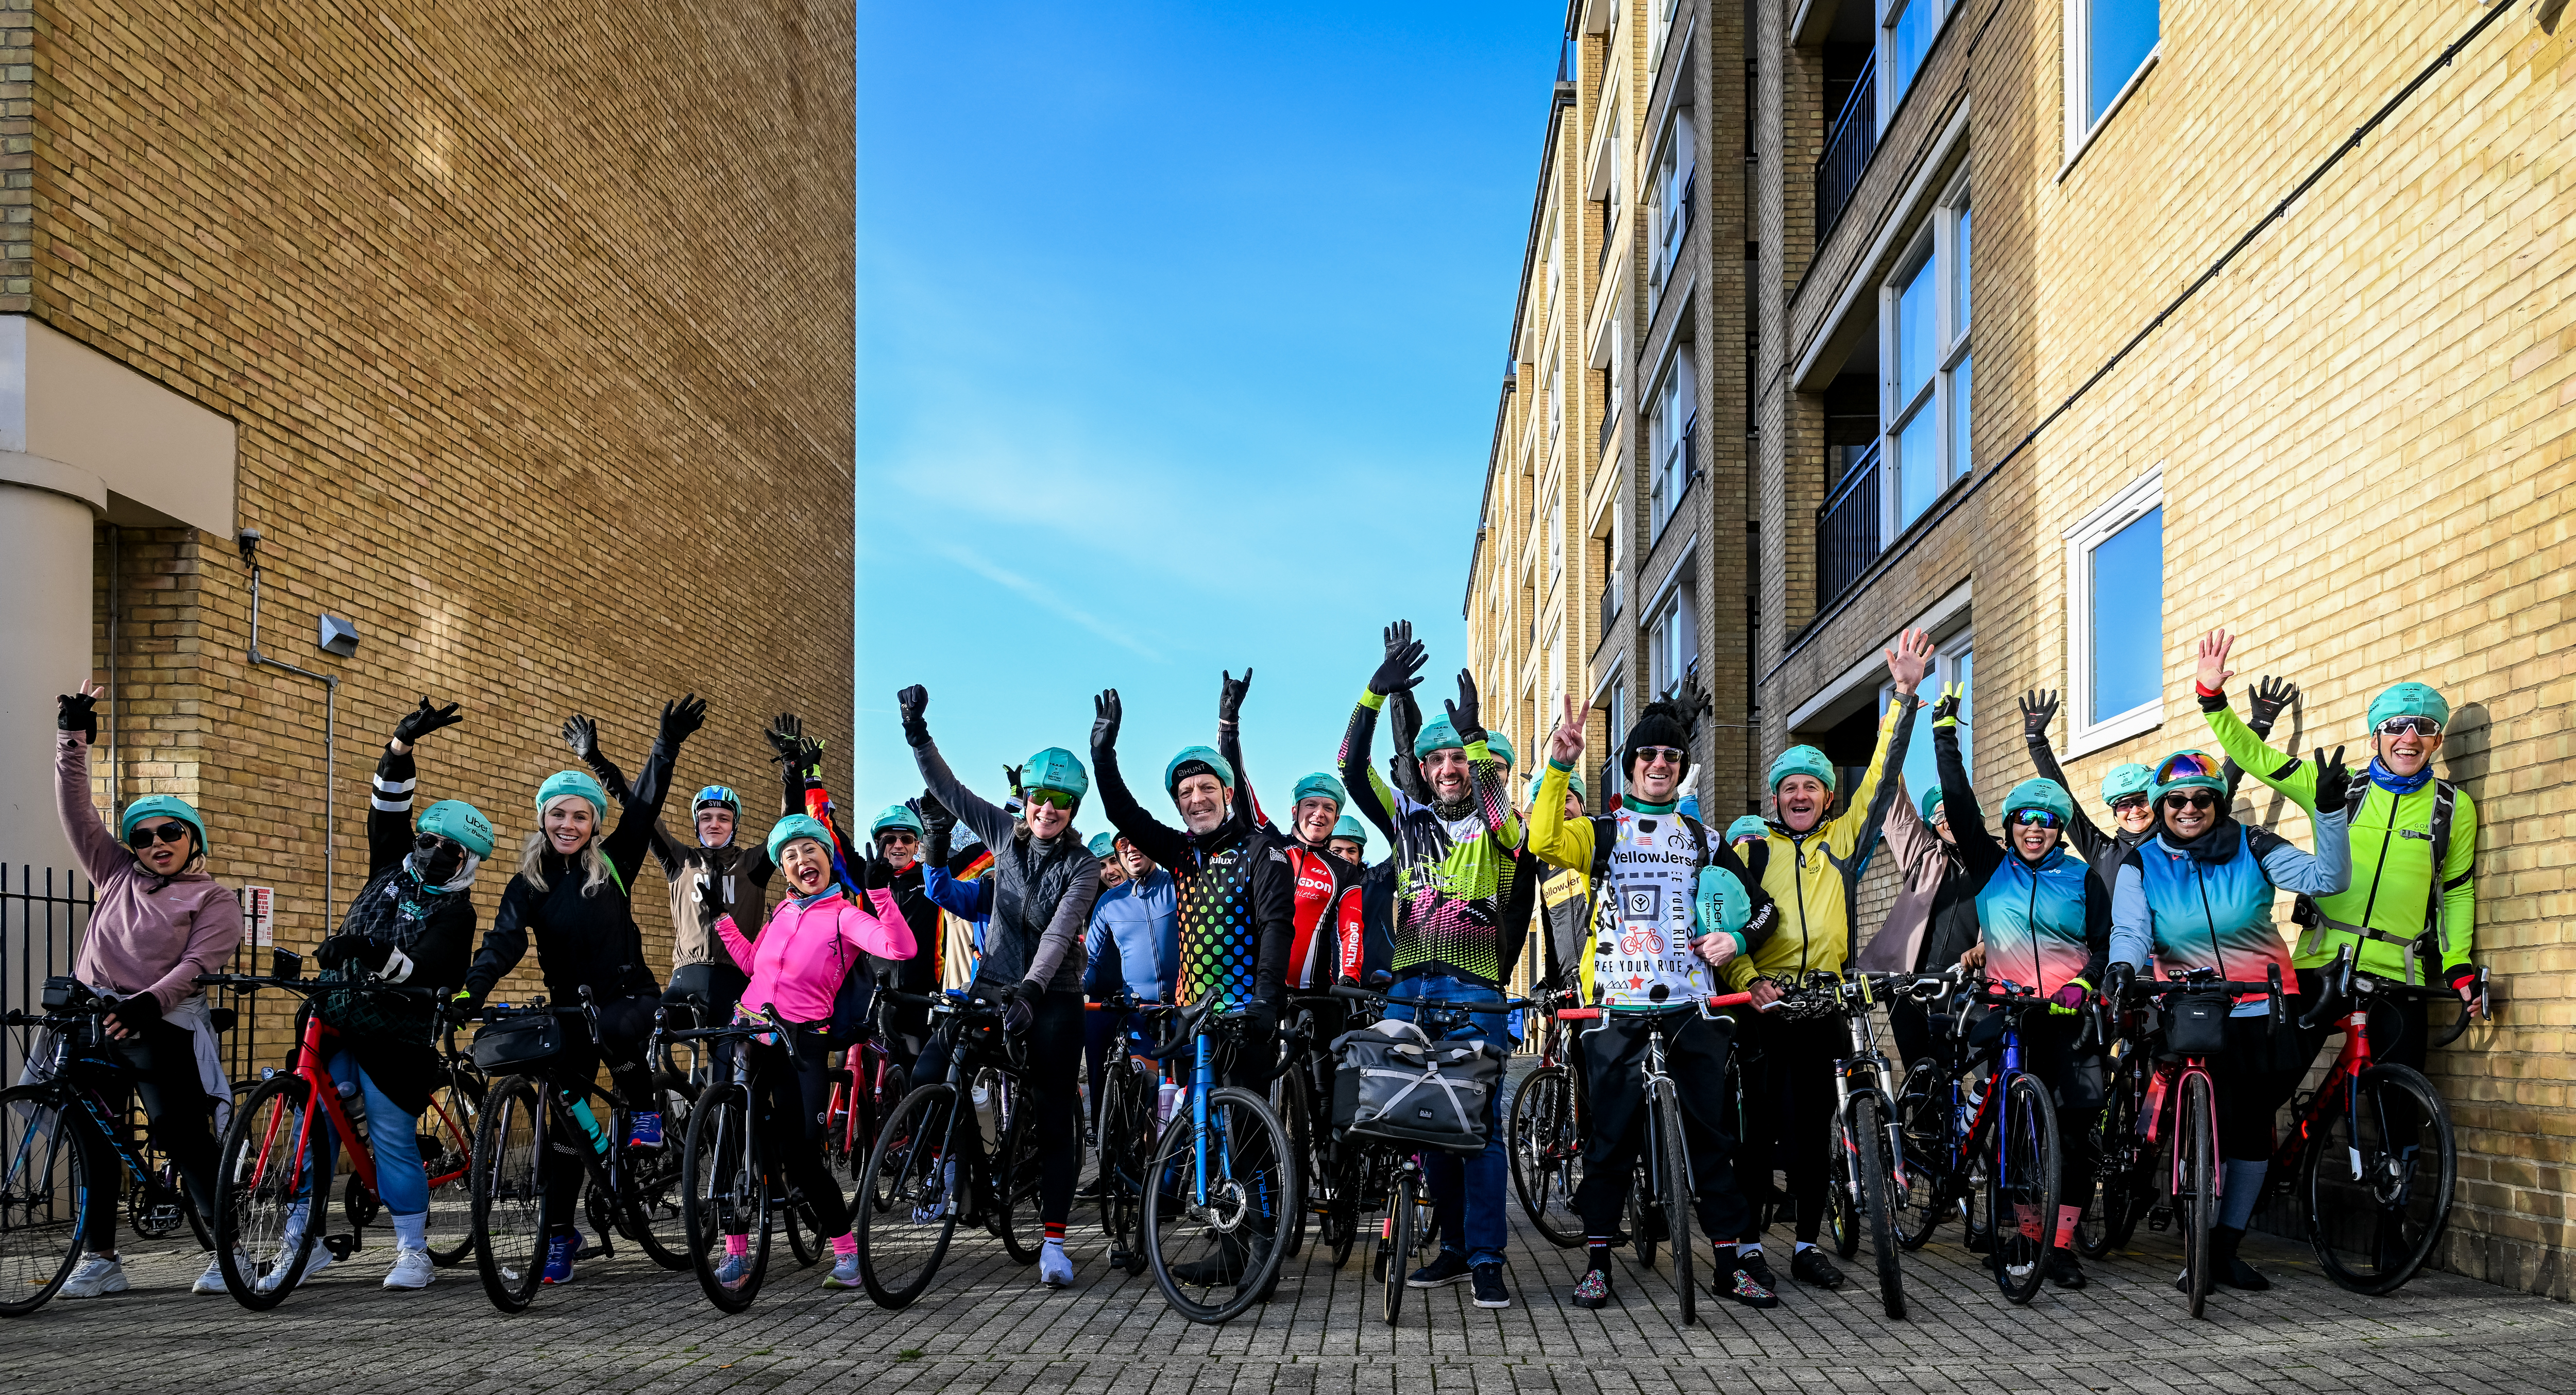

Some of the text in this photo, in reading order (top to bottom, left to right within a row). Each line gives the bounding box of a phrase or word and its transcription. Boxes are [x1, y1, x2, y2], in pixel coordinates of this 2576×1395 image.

[1184, 763, 1205, 775] HUNT
[463, 823, 471, 832] by
[471, 829, 488, 843] thames
[465, 814, 488, 833] Uber
[1209, 856, 1233, 865] Dulux
[1612, 851, 1697, 867] YellowJerse
[1808, 863, 1821, 871] GORE
[1294, 888, 1319, 900] hletes
[1543, 876, 1581, 900] YellowJer
[1703, 893, 1710, 901] by
[1672, 891, 1685, 920] YOUR
[1713, 893, 1724, 925] Uber
[1746, 902, 1774, 931] YellowJer
[1673, 929, 1685, 957] RIDE
[1594, 960, 1682, 972] REE YOUR RIDE
[774, 1027, 790, 1047] ULTEGRA
